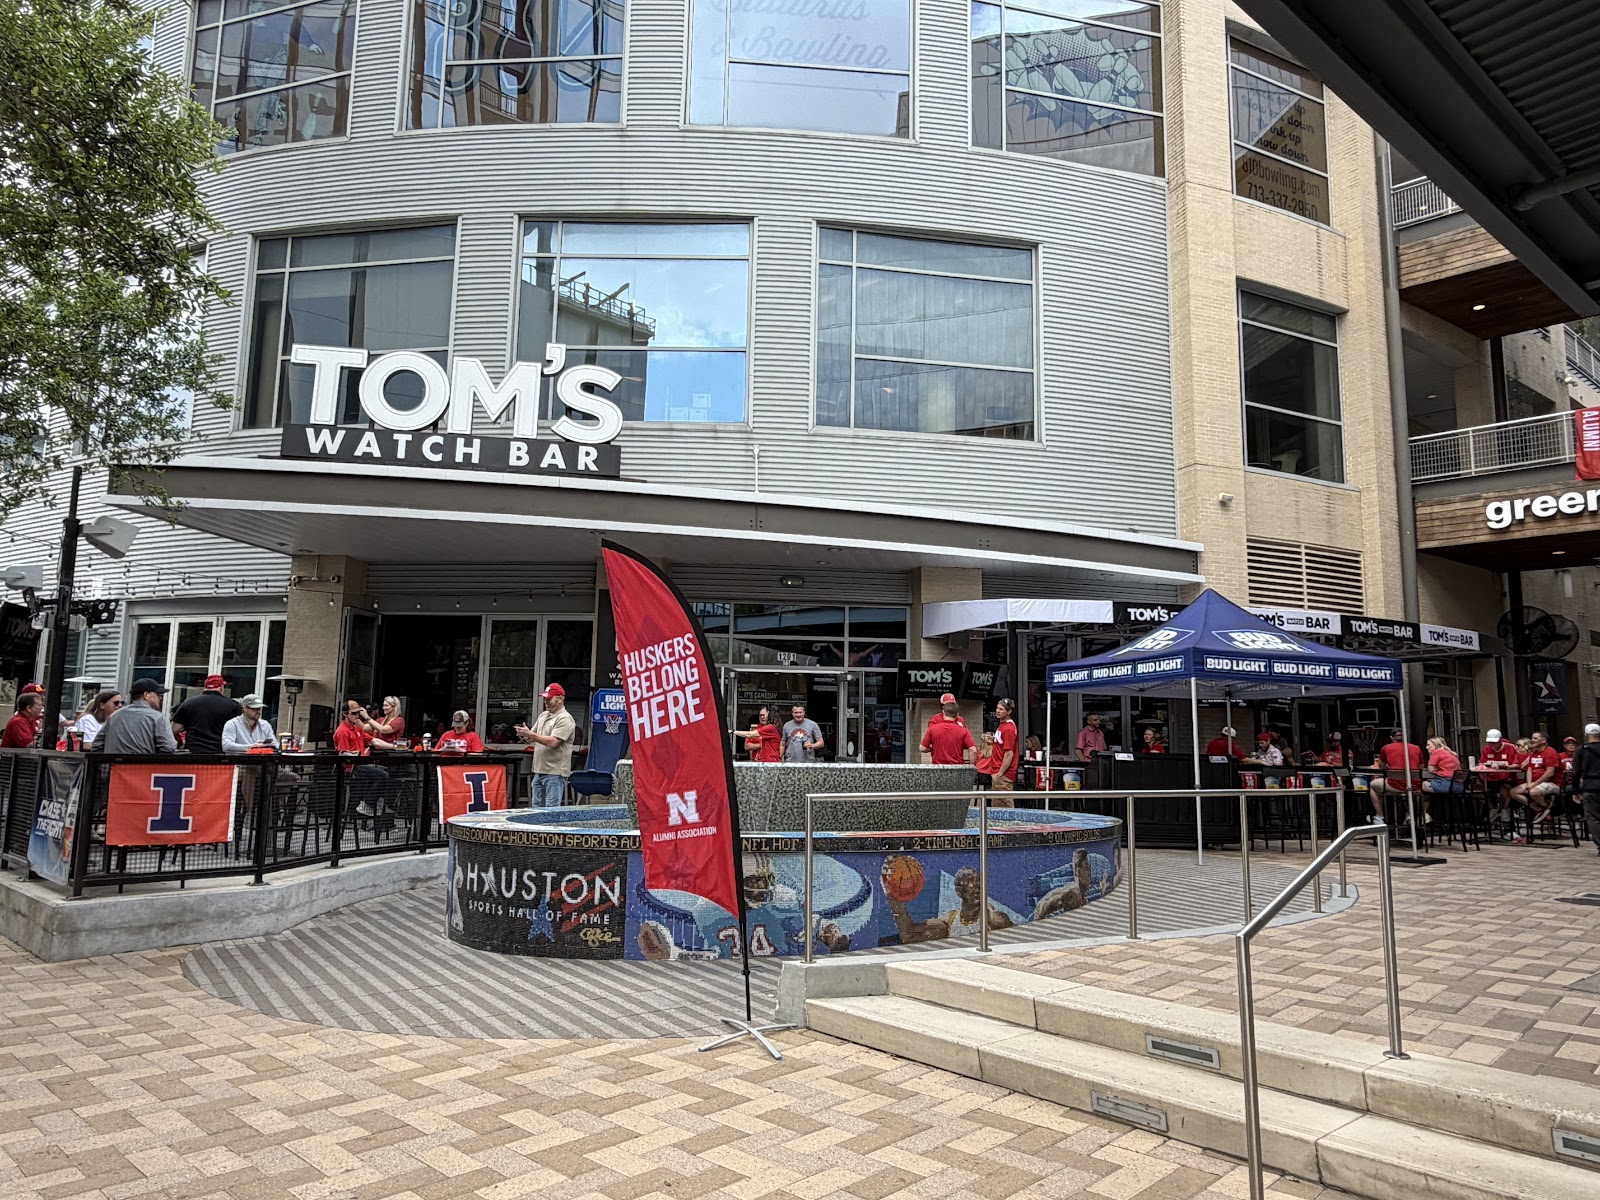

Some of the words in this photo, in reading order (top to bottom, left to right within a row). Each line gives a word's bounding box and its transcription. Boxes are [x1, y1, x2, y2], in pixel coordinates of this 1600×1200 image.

[741, 26, 892, 69] Bowling
[1281, 144, 1310, 163] down
[1242, 157, 1321, 198] 810bowling.com
[1248, 182, 1319, 222] 713-337-2950
[290, 342, 624, 444] TOM'S
[1582, 410, 1600, 452] ALUMNI
[305, 427, 481, 464] WATCH
[509, 441, 599, 472] BAR
[1127, 605, 1169, 622] TOM'S
[1306, 616, 1331, 630] BAR
[1350, 620, 1378, 634] TOM'S
[1393, 625, 1413, 638] BAR
[1228, 632, 1283, 642] BUD
[1428, 630, 1449, 643] TOM'S
[1460, 634, 1474, 647] BAR
[624, 633, 696, 676] HUSKERS
[1232, 641, 1306, 652] LIGHT
[1093, 667, 1109, 678] BUD
[1109, 665, 1132, 677] LIGHT
[1137, 662, 1156, 674] BUD
[1157, 659, 1182, 671] LIGHT
[1206, 658, 1233, 670] BUD
[1233, 659, 1266, 672] LIGHT
[1273, 663, 1298, 674] BUD
[1298, 664, 1331, 677] LIGHT
[627, 657, 699, 703] BELONG
[908, 668, 952, 683] TOM'S
[972, 671, 994, 686] TOM'S
[1054, 673, 1068, 683] BUD
[1068, 670, 1089, 682] LIGHT
[1337, 667, 1362, 679] BUD
[1361, 668, 1392, 680] LIGHT
[605, 695, 626, 703] BUD
[631, 682, 705, 742] HERE
[463, 771, 490, 814] I
[147, 773, 196, 834] I
[666, 789, 700, 826] N
[566, 835, 618, 848] SPORTS
[652, 832, 676, 842] ALUMNI
[677, 826, 717, 839] ASSOCIATION
[913, 837, 951, 849] 2-TIME
[952, 836, 973, 848] NBA
[973, 835, 1006, 848] CAMP
[1055, 830, 1083, 843] OLYMPIC
[742, 838, 770, 851] NFL
[772, 838, 800, 851] HOF
[469, 900, 503, 916] SPORTS
[509, 907, 538, 921] HALL
[546, 911, 562, 922] OF
[571, 912, 610, 925] FAME
